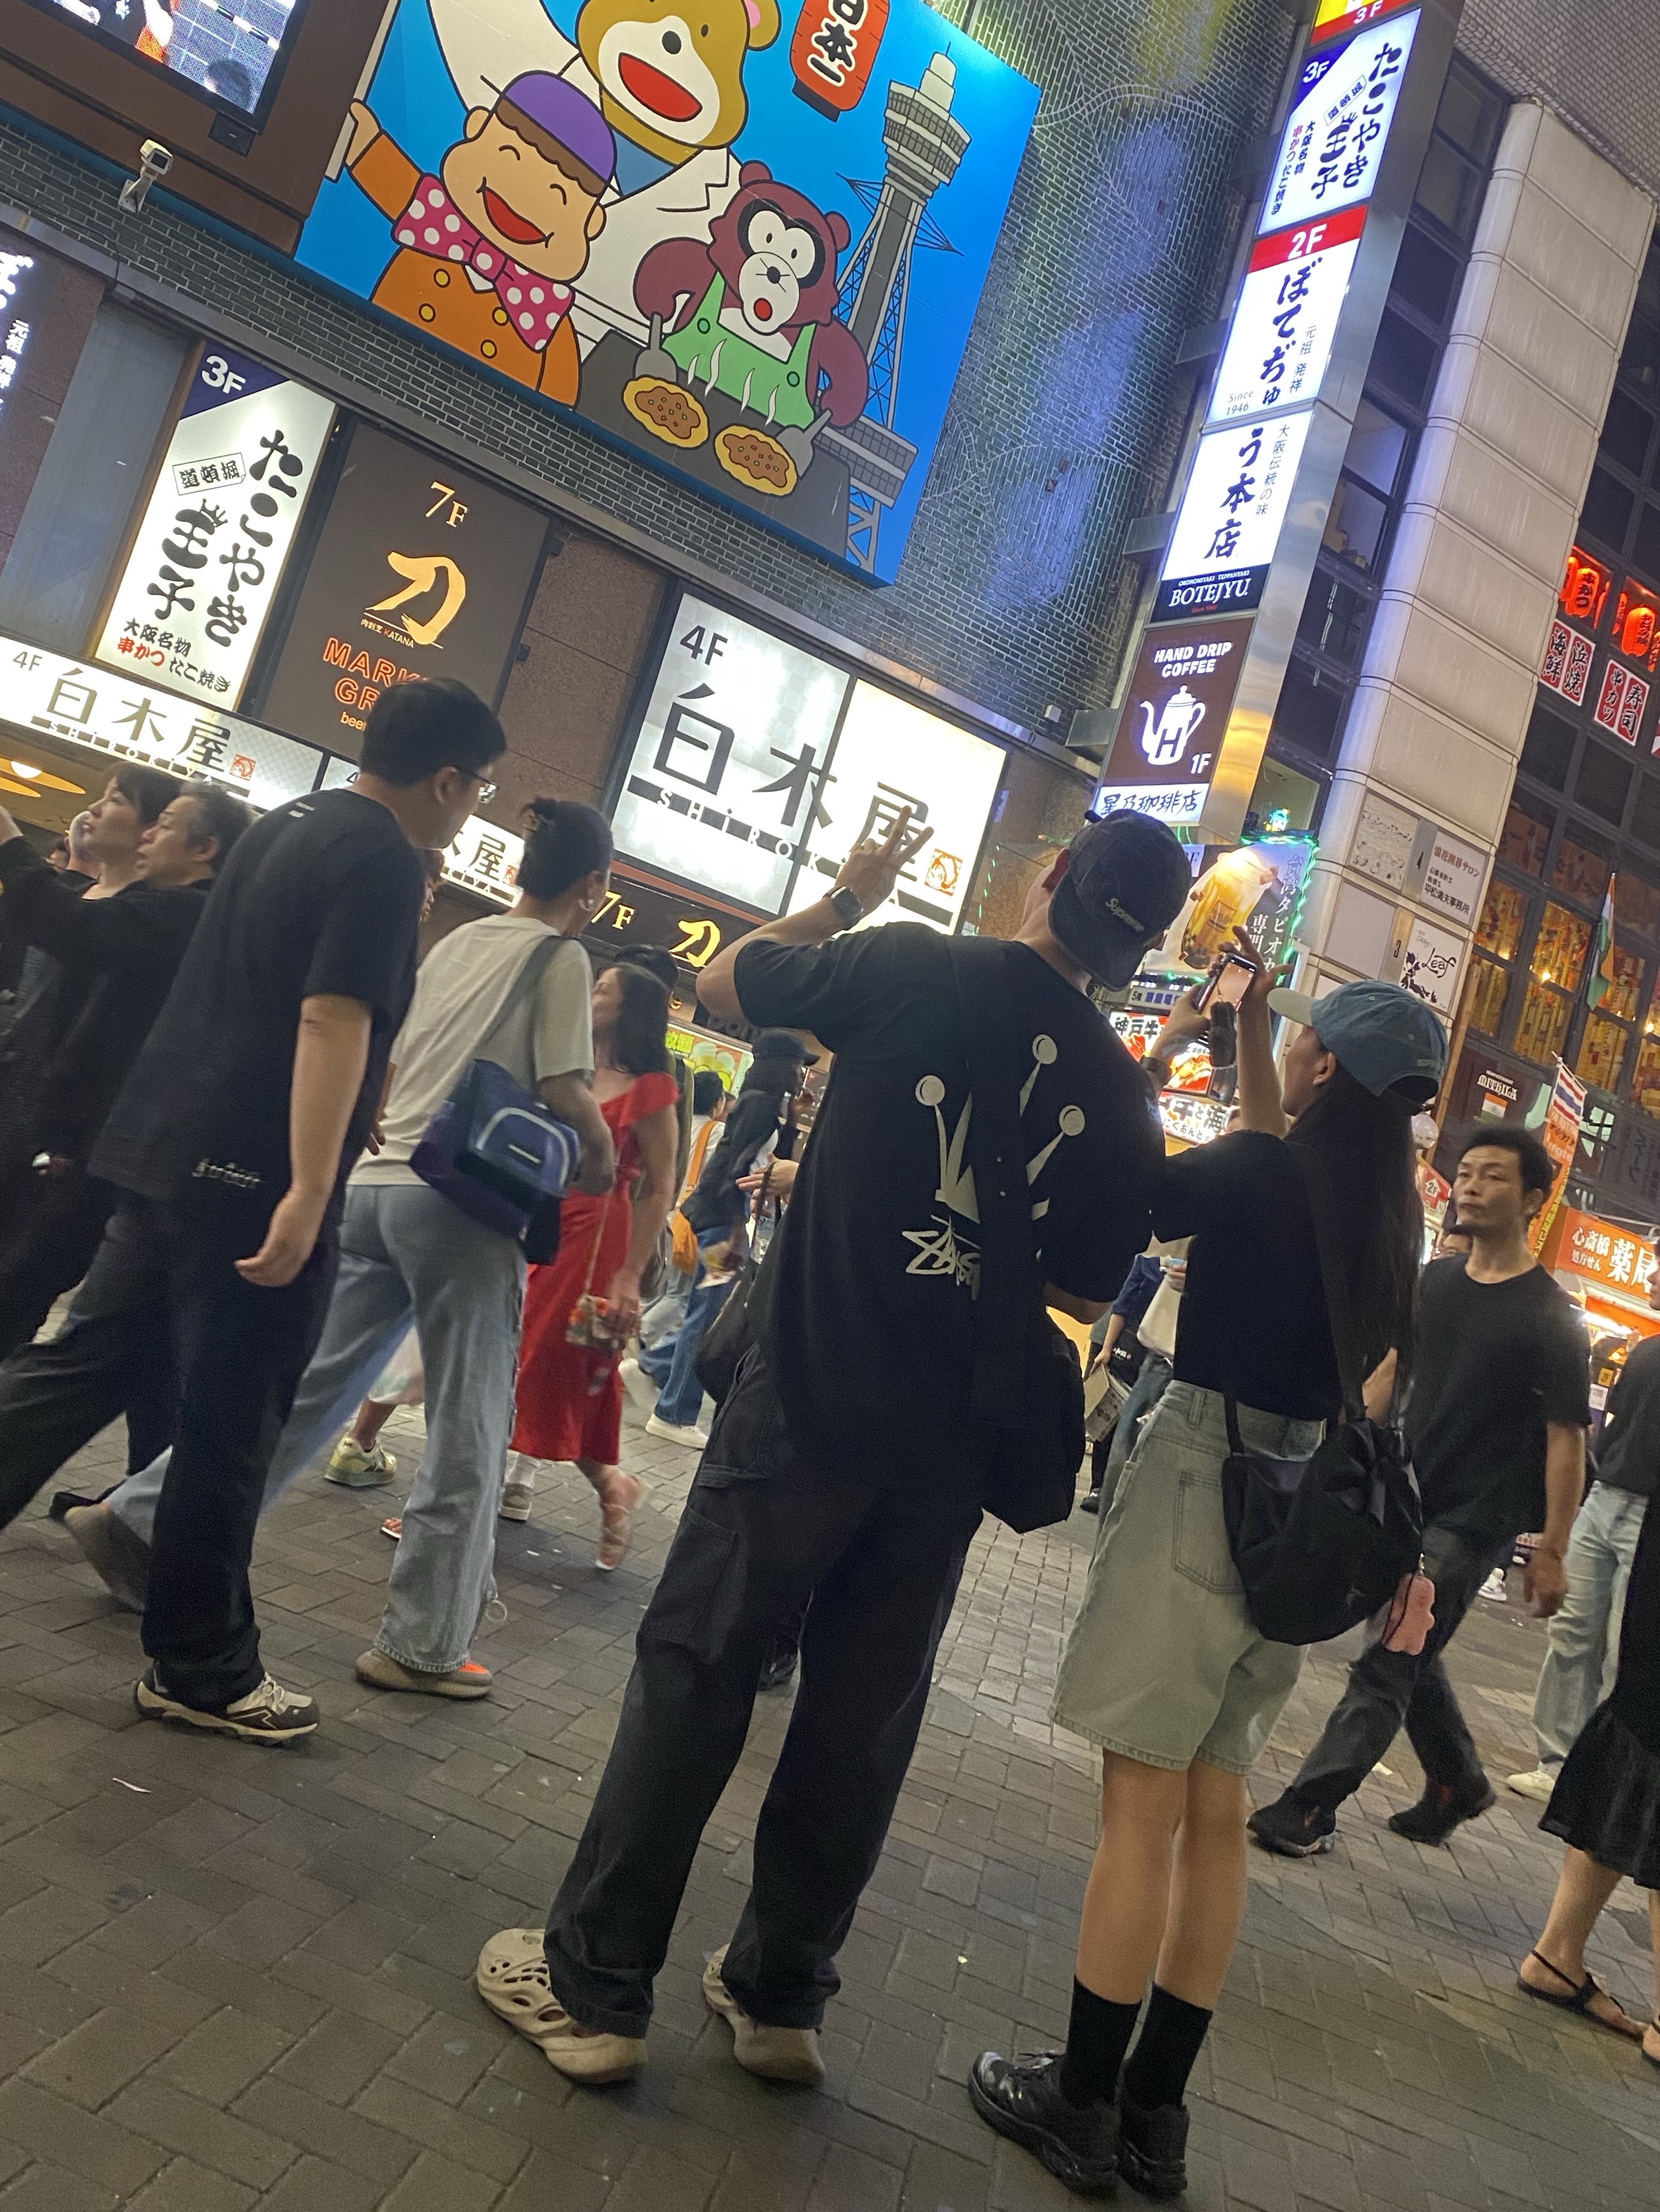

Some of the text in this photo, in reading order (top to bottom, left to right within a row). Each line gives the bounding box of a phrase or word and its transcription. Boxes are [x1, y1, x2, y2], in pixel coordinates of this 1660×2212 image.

[1353, 0, 1384, 24] 3F
[1302, 60, 1330, 83] 3F
[1342, 43, 1402, 188] たこやき
[1288, 224, 1328, 260] 2F
[1300, 325, 1316, 356] 元祖
[201, 354, 246, 395] 3F
[1226, 402, 1249, 415] 1946
[1228, 389, 1254, 403] Since
[179, 460, 241, 489] 道頓堀
[1255, 424, 1290, 516] 大阪伝統の味
[425, 481, 468, 527] 7F
[205, 429, 303, 647] たこやき
[124, 617, 191, 658] 大阪名物
[384, 628, 414, 648] KATANA
[680, 626, 728, 666] 4F
[1154, 641, 1232, 663] HAND DRIP
[13, 651, 43, 672] 4F
[118, 637, 231, 694] 串かつ たこ焼き
[1161, 659, 1217, 678] COFFEE
[1542, 627, 1567, 682] 海鮮
[1564, 642, 1588, 696] 浜焼
[1603, 668, 1623, 722] 串カツ
[1622, 684, 1643, 738] 寿司
[47, 667, 231, 773] 白木屋
[1191, 753, 1211, 774] 1F
[652, 682, 929, 882] 白木屋
[1100, 790, 1203, 816] 星乃珈琲店
[591, 891, 635, 930] 7F
[1421, 947, 1456, 978] Leaf
[1115, 1016, 1164, 1040] 神戸牛
[1572, 1226, 1611, 1257] 心斎橋
[1571, 1248, 1602, 1272] 処方せん
